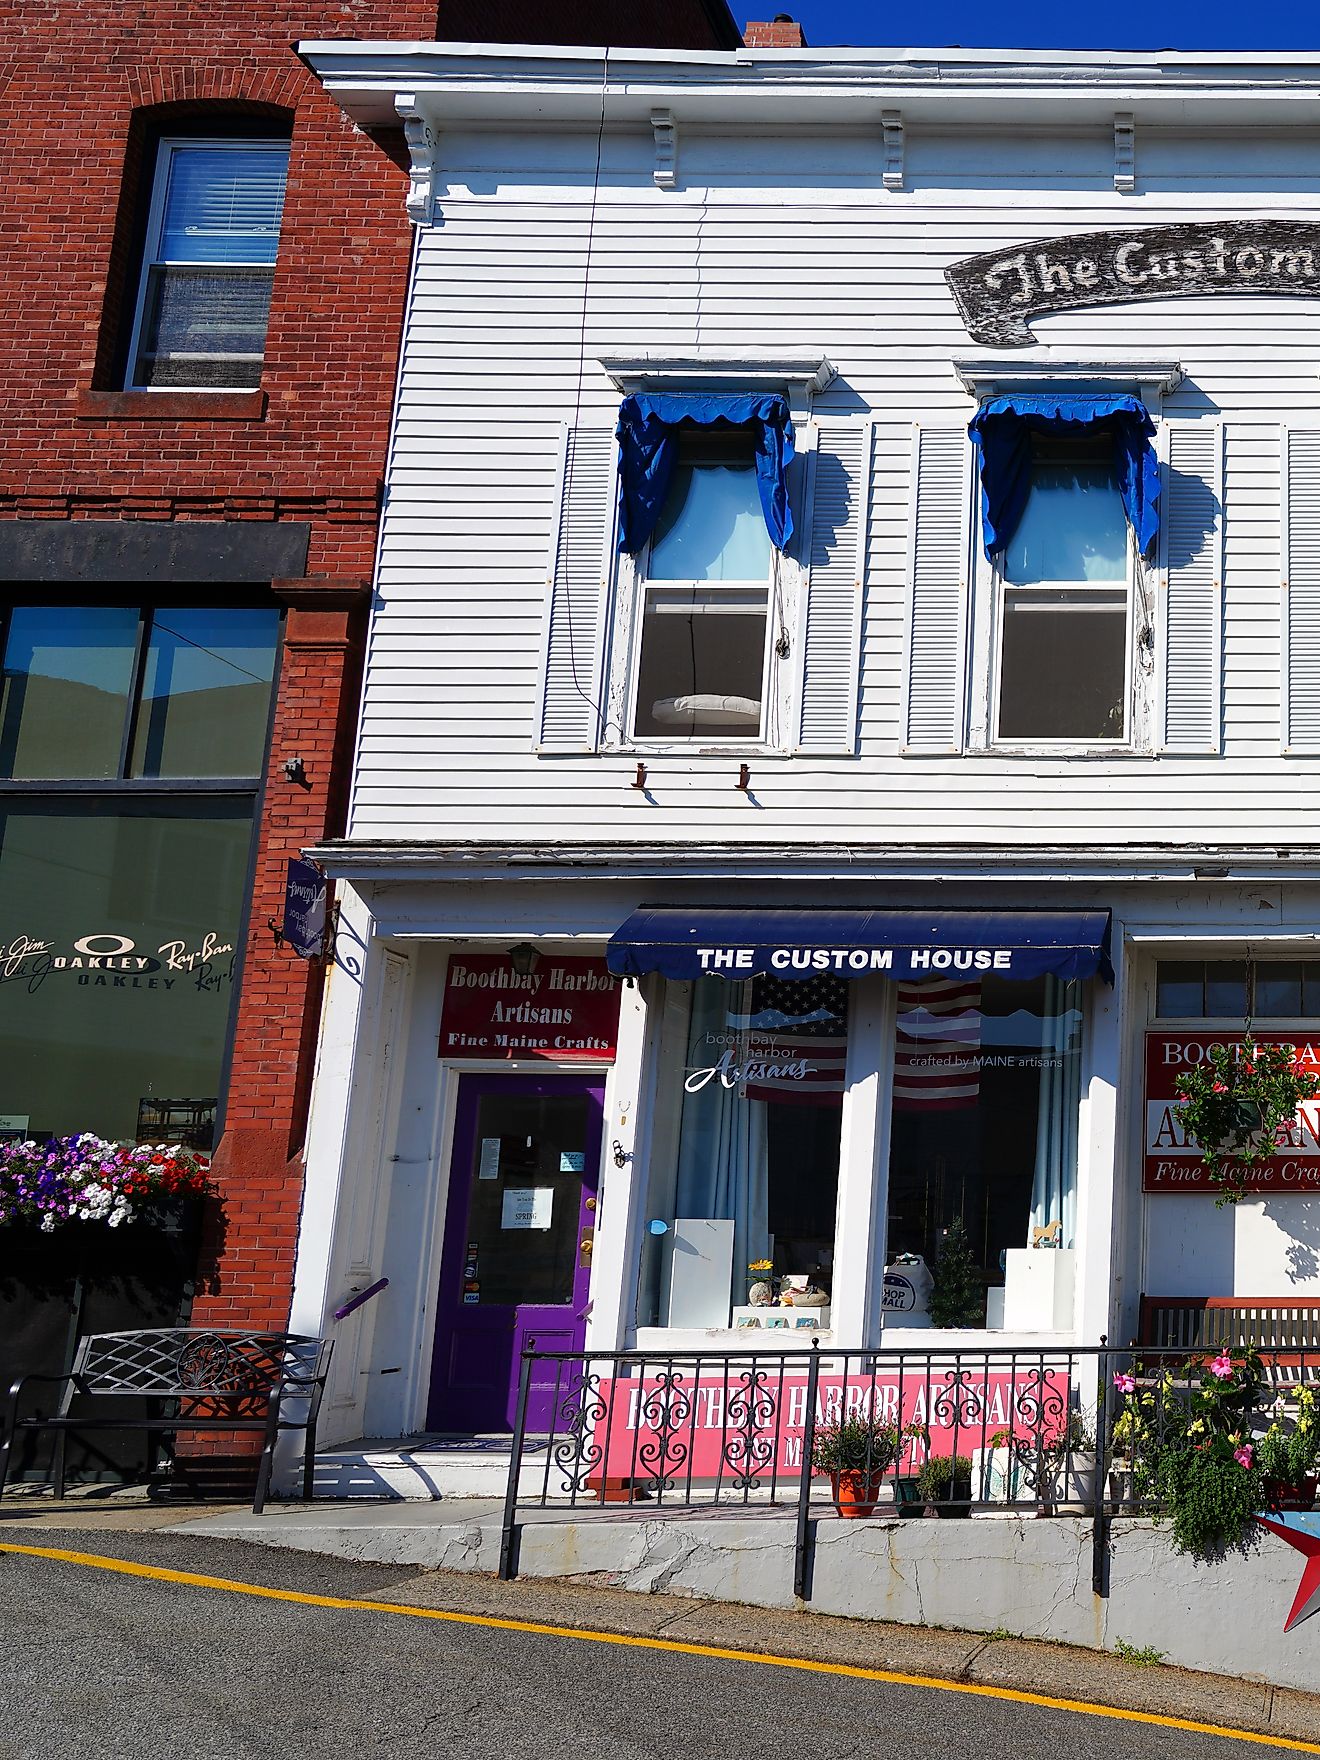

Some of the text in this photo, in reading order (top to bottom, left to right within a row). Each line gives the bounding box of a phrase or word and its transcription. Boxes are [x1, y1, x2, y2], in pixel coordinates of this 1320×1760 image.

[985, 252, 1099, 302] The
[1112, 236, 1315, 286] Custom
[54, 956, 148, 969] OAKLEY
[696, 949, 1012, 969] THE CUSTOM HOUSE
[450, 965, 545, 995] Boothbay
[490, 1000, 573, 1024] Artisans
[447, 1032, 609, 1049] Fine Maine Crafts
[705, 1031, 778, 1051] boothbay
[745, 1044, 798, 1058] harbor
[684, 1049, 818, 1093] Artisans
[909, 1055, 1063, 1069] crafted by MAINE artisans
[1154, 1161, 1202, 1181] Fine
[515, 1212, 537, 1220] SPRING
